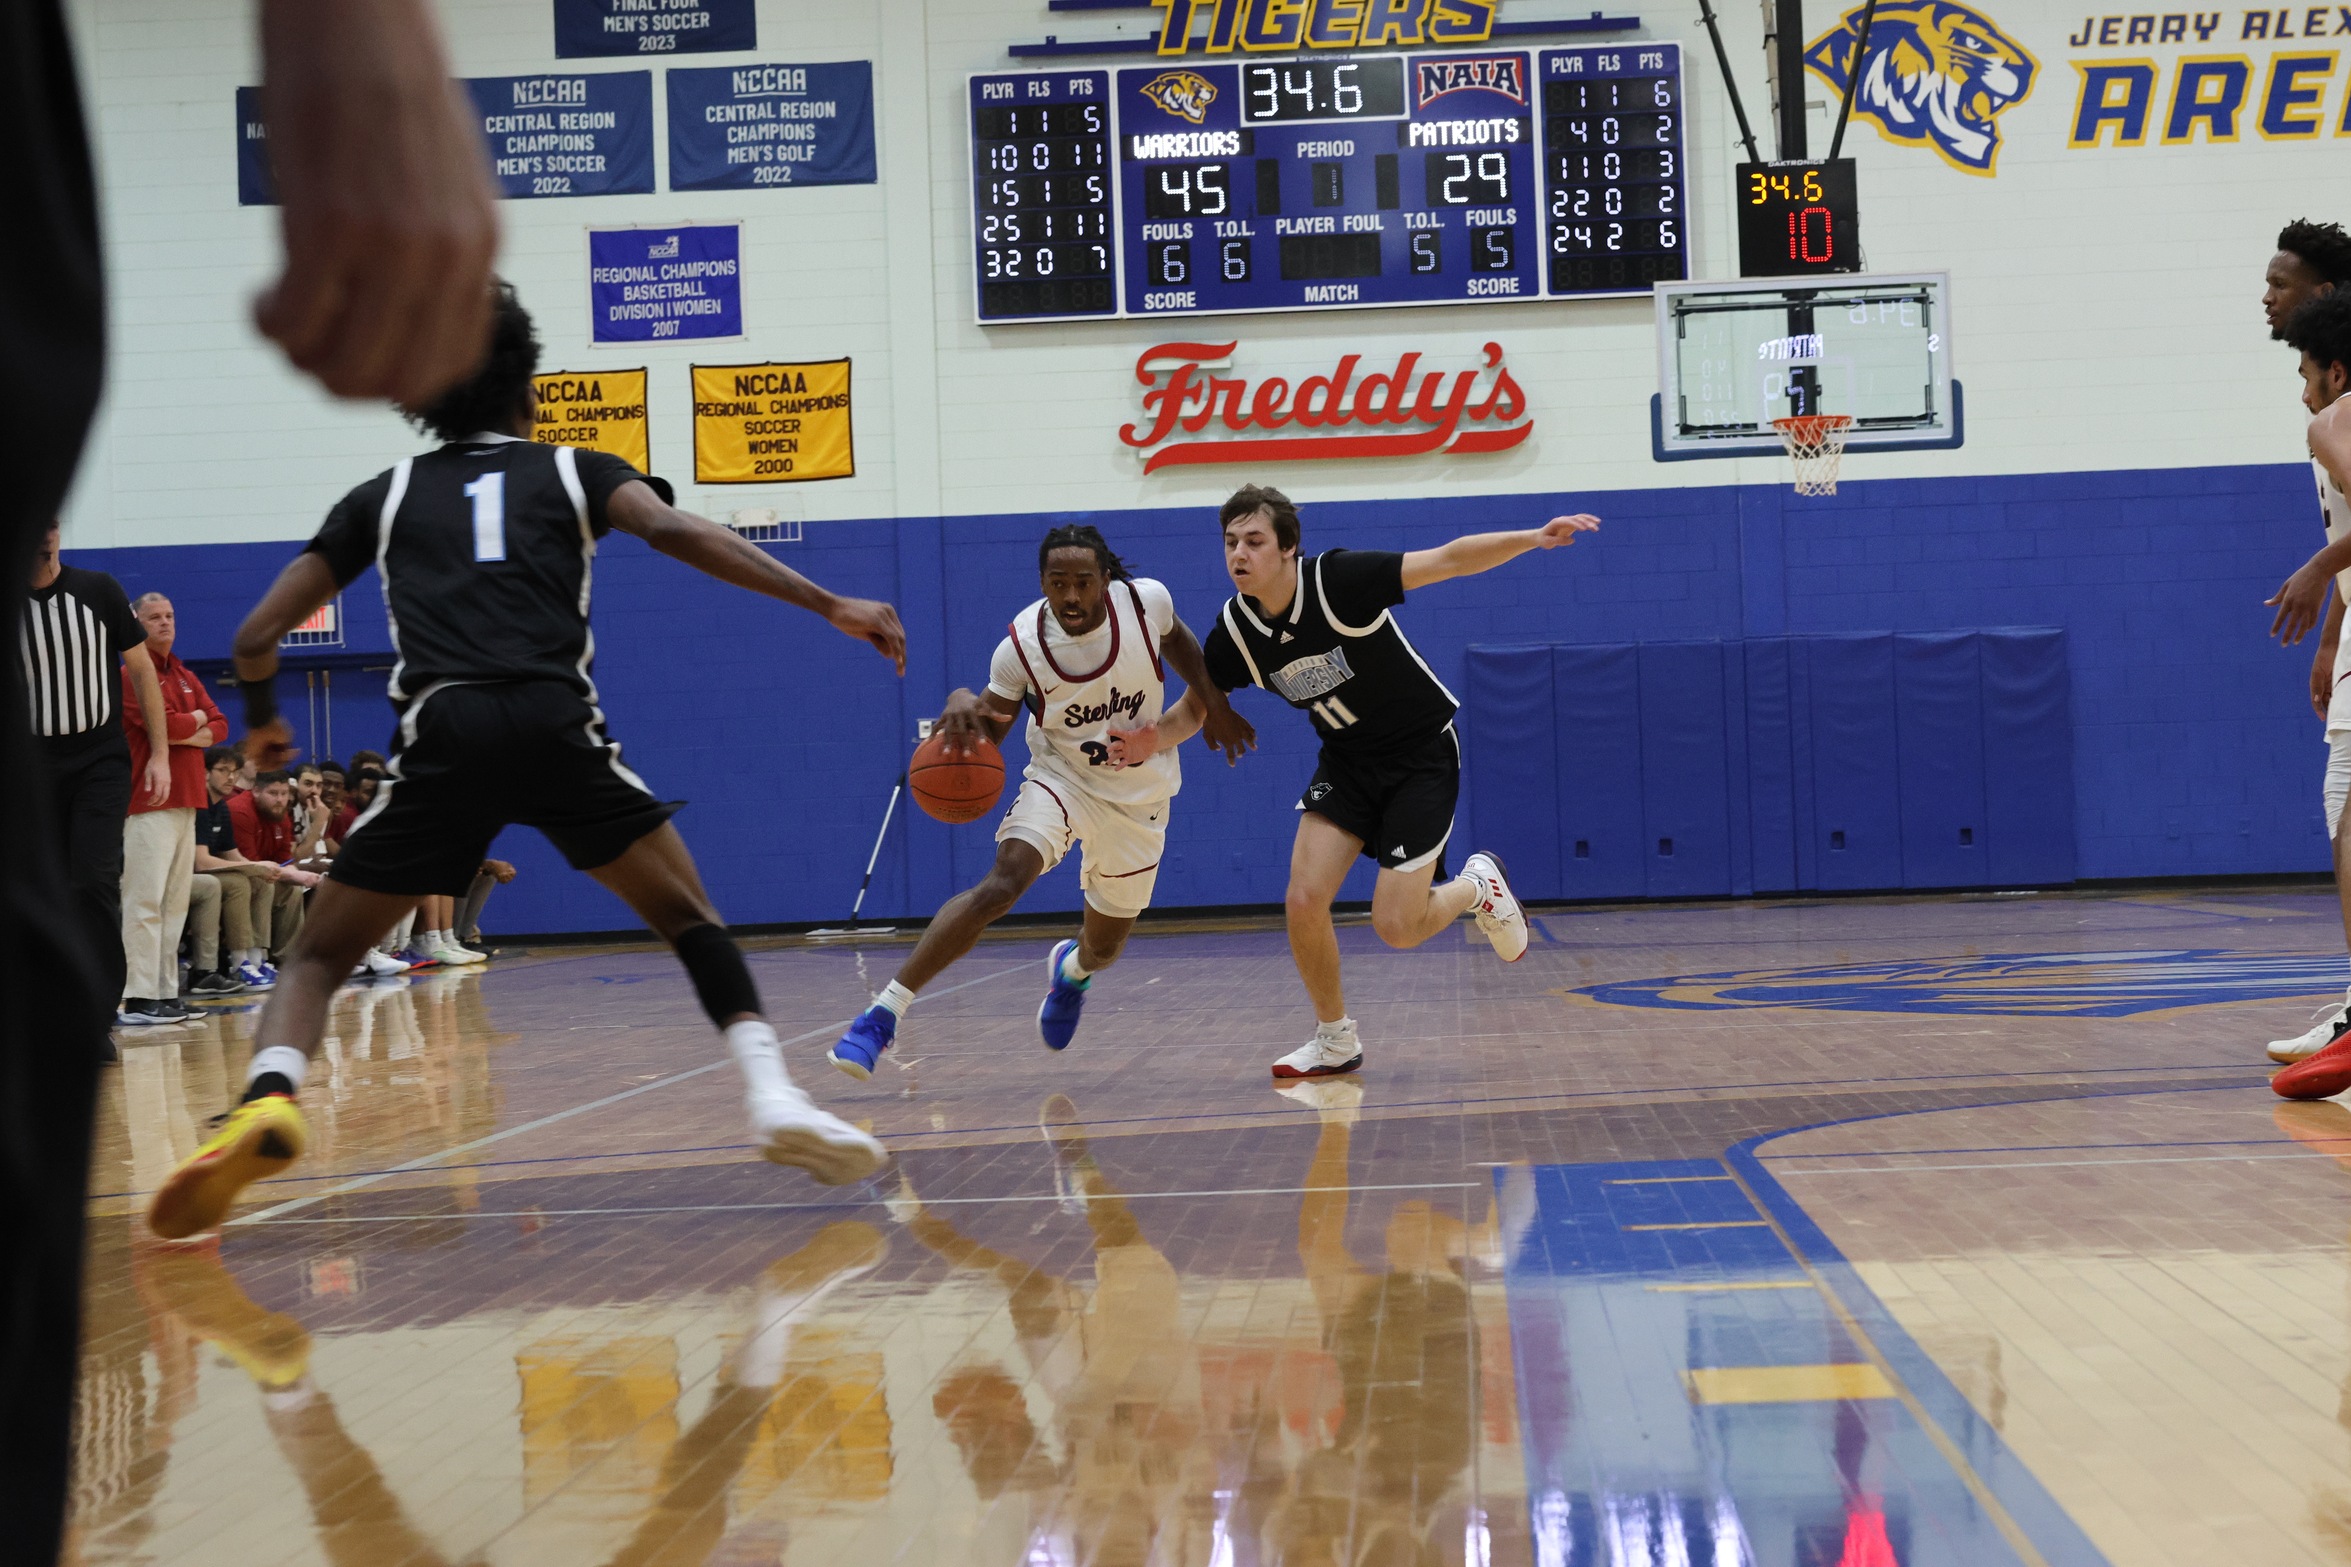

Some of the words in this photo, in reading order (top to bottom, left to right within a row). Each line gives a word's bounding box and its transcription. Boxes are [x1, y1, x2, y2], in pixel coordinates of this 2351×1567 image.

[612, 0, 657, 12] FINAL
[604, 16, 648, 32] MEN'S
[652, 12, 710, 31] SOCCER
[1157, 0, 1498, 56] TIGERS
[2070, 12, 2222, 48] JERRY
[638, 34, 676, 51] 2023
[1552, 56, 1583, 74] PLYR
[1598, 54, 1620, 71] FLS
[1640, 52, 1664, 70] PTS
[732, 68, 807, 94] NCCAA
[983, 82, 1014, 99] PLYR
[1028, 81, 1050, 97] FLS
[1070, 79, 1093, 96] PTS
[1252, 64, 1363, 117] 34.6
[1420, 58, 1524, 101] NAIA
[513, 79, 586, 105] NCCAA
[1580, 86, 1586, 108] 1
[1612, 84, 1618, 107] 1
[1654, 80, 1671, 107] 6
[2066, 49, 2351, 150] ARE
[486, 113, 556, 133] CENTRAL
[560, 112, 615, 130] REGION
[706, 102, 776, 123] CENTRAL
[780, 101, 836, 119] REGION
[1011, 112, 1017, 133] 1
[1043, 111, 1048, 132] 1
[1084, 106, 1100, 133] 5
[727, 123, 816, 143] CHAMPIONS
[1410, 118, 1520, 147] PATRIOTS
[1570, 121, 1587, 143] 4
[1602, 117, 1619, 145] 0
[1656, 115, 1672, 143] 2
[506, 134, 595, 154] CHAMPIONS
[728, 145, 773, 165] MEN'S
[777, 144, 816, 162] GOLF
[1133, 131, 1240, 159] WARRIORS
[1297, 140, 1354, 159] PERIOD
[496, 157, 543, 176] MEN'S
[546, 155, 606, 173] SOCCER
[991, 144, 1018, 172] 10
[1032, 143, 1049, 170] 0
[1562, 156, 1589, 180] 11
[1604, 152, 1620, 180] 0
[1660, 150, 1674, 178] 3
[1768, 158, 1825, 168] DAKTRONICS
[533, 177, 571, 195] 2022
[753, 166, 792, 184] 2022
[1443, 153, 1507, 204] 29
[992, 179, 1019, 206] 15
[1045, 180, 1051, 202] 1
[1086, 176, 1103, 203] 5
[1162, 165, 1226, 214] 45
[1751, 171, 1823, 204] 34.6
[1552, 189, 1590, 218] 22
[1605, 188, 1622, 215] 0
[1658, 185, 1675, 213] 2
[983, 214, 1021, 243] 25
[1046, 216, 1052, 238] 1
[1275, 216, 1335, 236] PLAYER
[1344, 214, 1384, 232] FOUL
[1404, 210, 1445, 228] T.O.L.
[1466, 208, 1517, 226] FOULS
[1142, 223, 1194, 242] FOULS
[1214, 220, 1256, 239] T.O.L.
[1554, 225, 1591, 253] 24
[1606, 223, 1623, 251] 2
[1660, 220, 1677, 248] 6
[1789, 207, 1833, 262] 10
[1223, 242, 1246, 280] 6
[1412, 234, 1435, 271] 5
[1486, 230, 1508, 268] 5
[593, 266, 658, 284] REGIONAL
[660, 260, 736, 281] CHAMPIONS
[987, 249, 1022, 278] 32
[1036, 248, 1053, 276] 0
[1092, 246, 1106, 271] 7
[1162, 245, 1185, 283] 6
[624, 281, 706, 302] BASKETBALL
[1304, 285, 1359, 303] MATCH
[1467, 278, 1520, 296] SCORE
[610, 302, 664, 321] DIVISION
[667, 302, 672, 317] I
[672, 299, 721, 316] WOMEN
[1144, 292, 1197, 310] SCORE
[652, 320, 680, 338] 2007
[533, 380, 603, 404] NCCAA
[735, 372, 808, 397] NCCAA
[566, 405, 645, 422] CHAMPIONS
[696, 402, 763, 417] REGIONAL
[770, 394, 849, 414] CHAMPIONS
[1119, 340, 1534, 475] Freddy's
[537, 427, 598, 443] SOCCER
[744, 419, 801, 436] SOCCER
[748, 439, 799, 455] WOMEN
[754, 458, 794, 475] 2000
[464, 471, 507, 562] 1
[296, 607, 326, 629] XIT
[1064, 686, 1146, 728] Sterling
[1311, 695, 1360, 730] 11
[1080, 736, 1145, 768] 2
